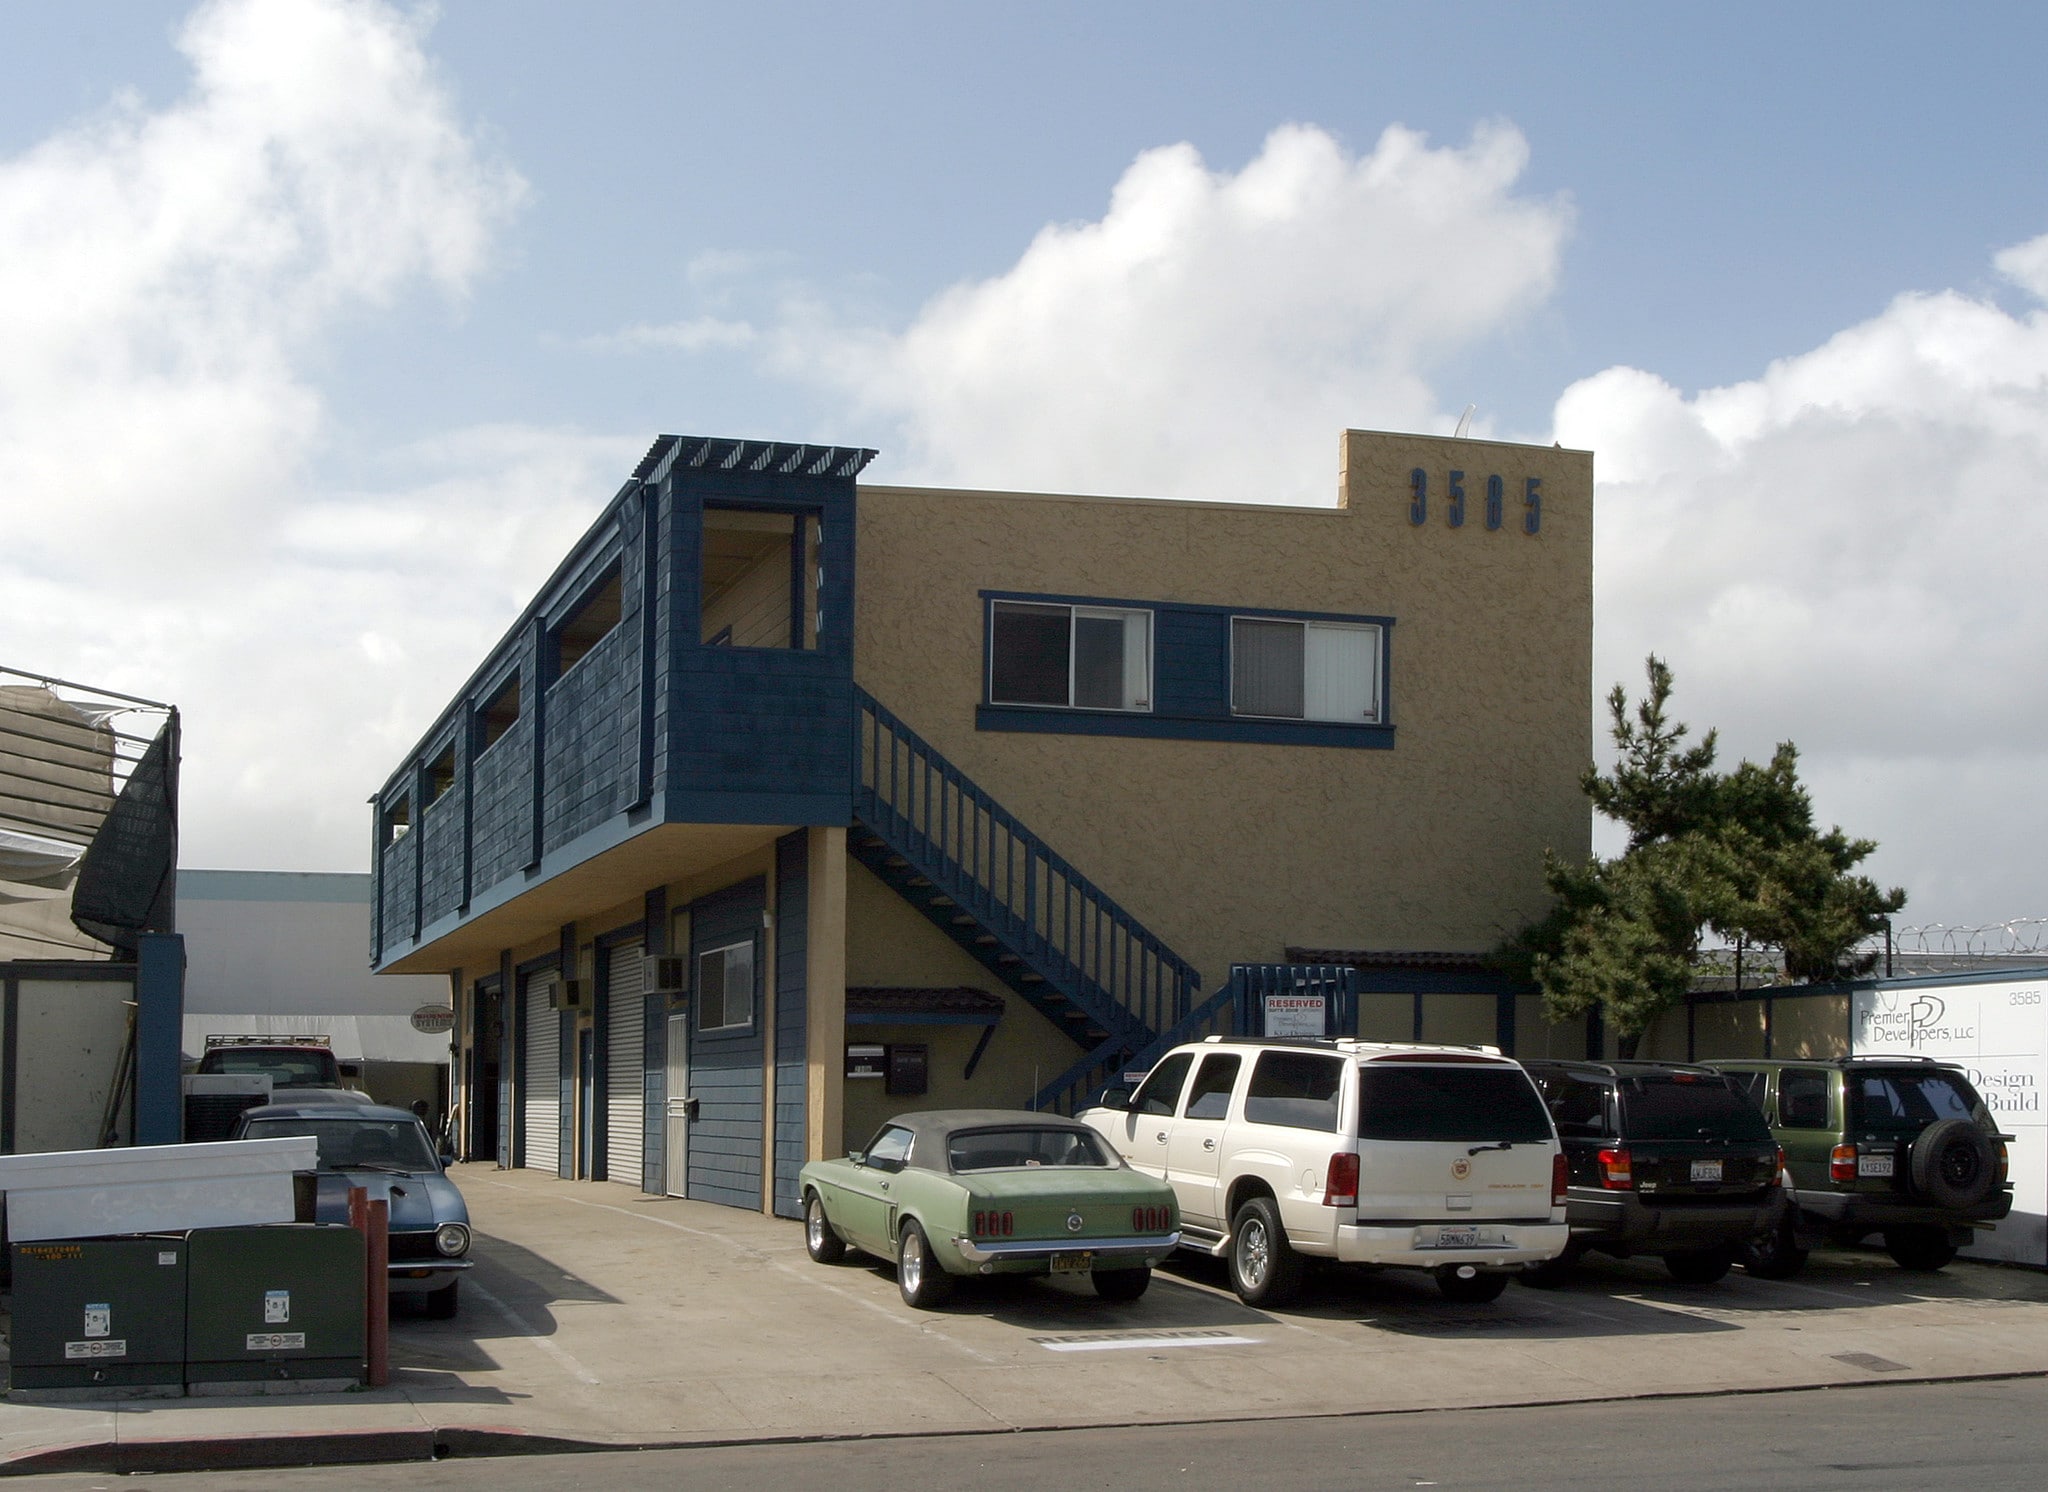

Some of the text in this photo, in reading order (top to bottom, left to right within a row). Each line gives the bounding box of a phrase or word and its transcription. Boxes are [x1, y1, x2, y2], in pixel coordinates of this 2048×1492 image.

[1410, 467, 1542, 535] 3585
[1268, 999, 1323, 1008] RESERVED
[2009, 991, 2041, 1006] 3585
[1860, 1010, 1910, 1026] Premier
[1954, 1027, 1975, 1039] LLC
[1966, 1069, 2034, 1094] Design
[1983, 1092, 2039, 1112] Build
